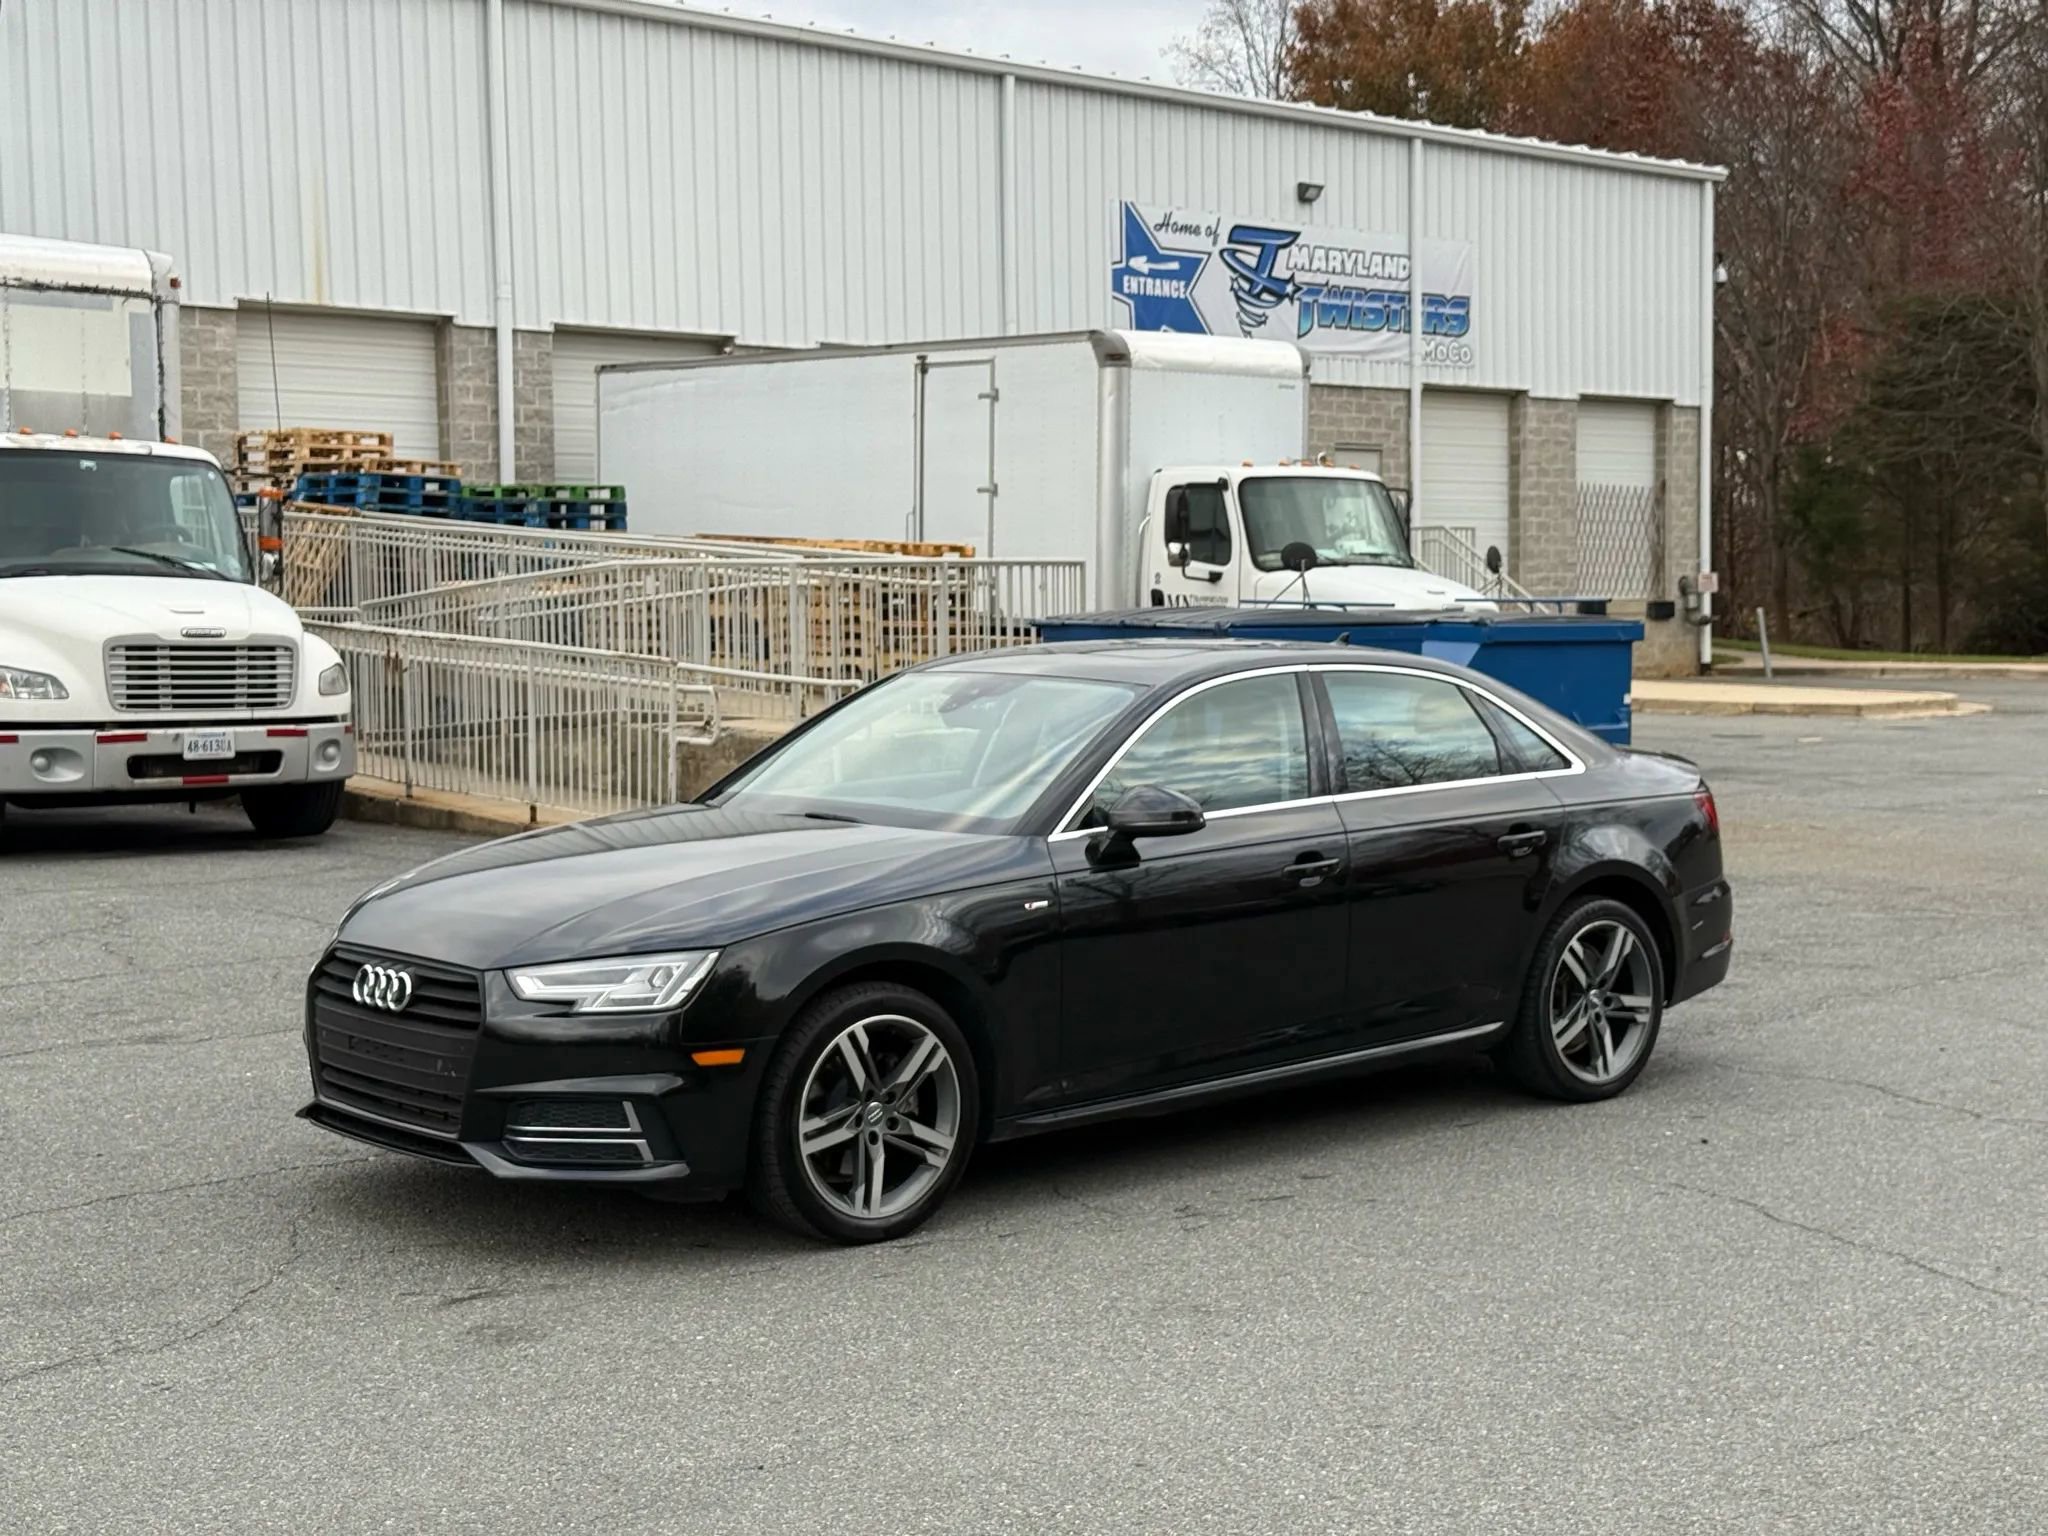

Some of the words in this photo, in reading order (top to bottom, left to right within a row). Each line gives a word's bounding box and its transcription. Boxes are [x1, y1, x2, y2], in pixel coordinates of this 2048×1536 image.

[1153, 211, 1201, 236] Home
[1205, 216, 1221, 247] of
[1286, 244, 1411, 281] MARYLAND
[1123, 275, 1186, 299] ENTRANCE
